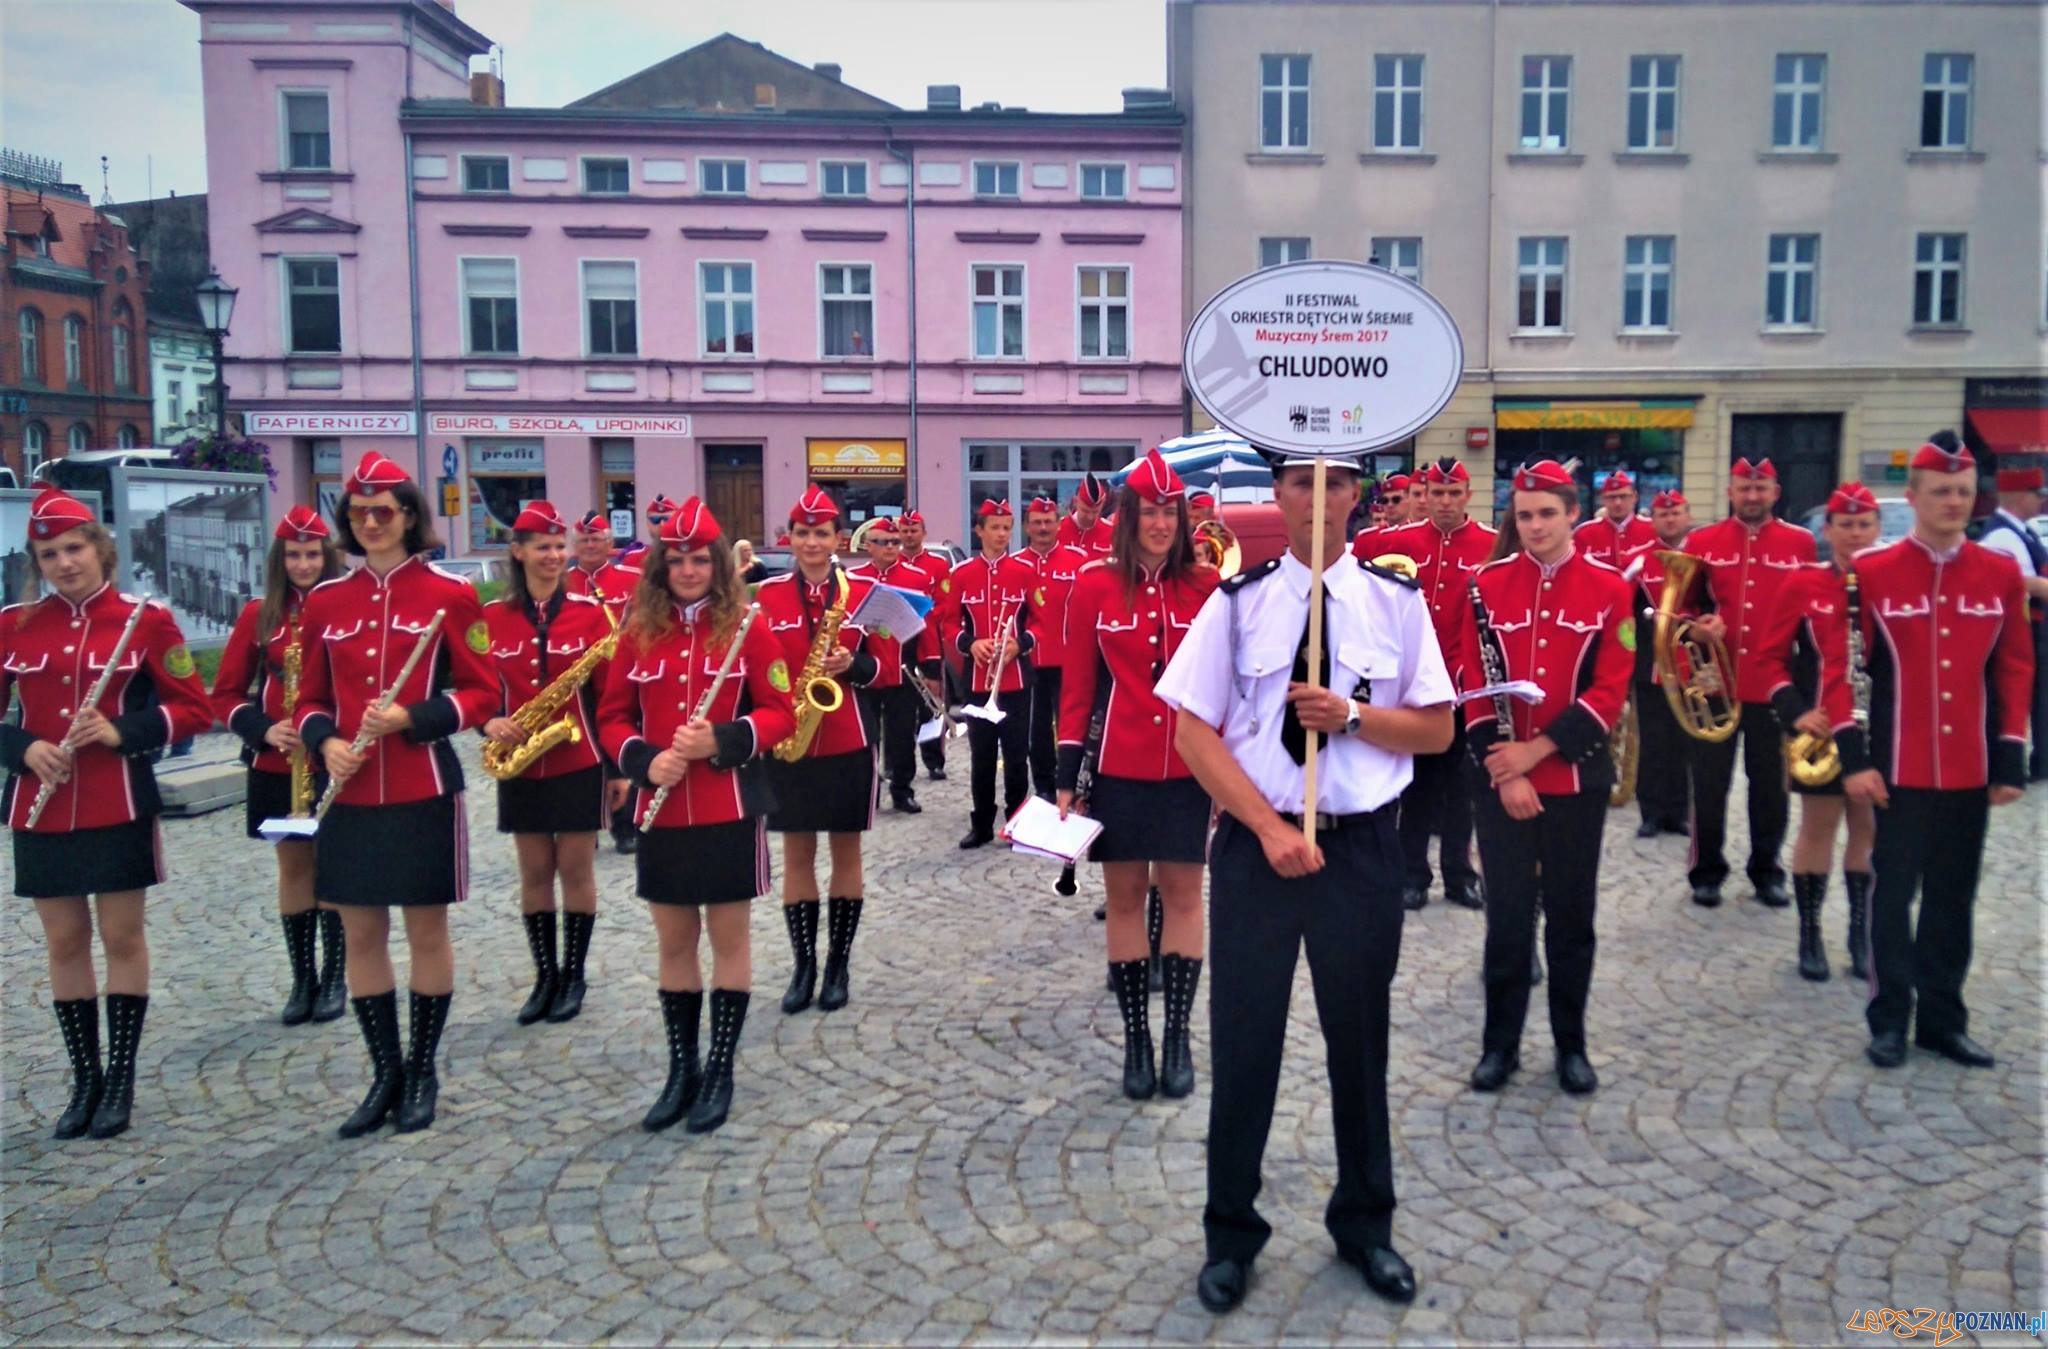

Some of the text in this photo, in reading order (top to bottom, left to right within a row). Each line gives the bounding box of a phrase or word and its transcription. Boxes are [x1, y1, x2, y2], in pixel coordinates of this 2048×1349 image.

[1285, 294, 1360, 307] II FESTIWAL
[1231, 310, 1415, 327] ORKIESTR DĘTYCH W ŚREMIE
[1255, 327, 1389, 344] Muzyczny Śrem 2017
[1258, 355, 1389, 378] CHLUDOWO
[257, 417, 401, 429] PAPIERNICZY
[436, 417, 682, 431] BIURO, SZKOŁA, UPOMINKI
[481, 448, 535, 462] profit
